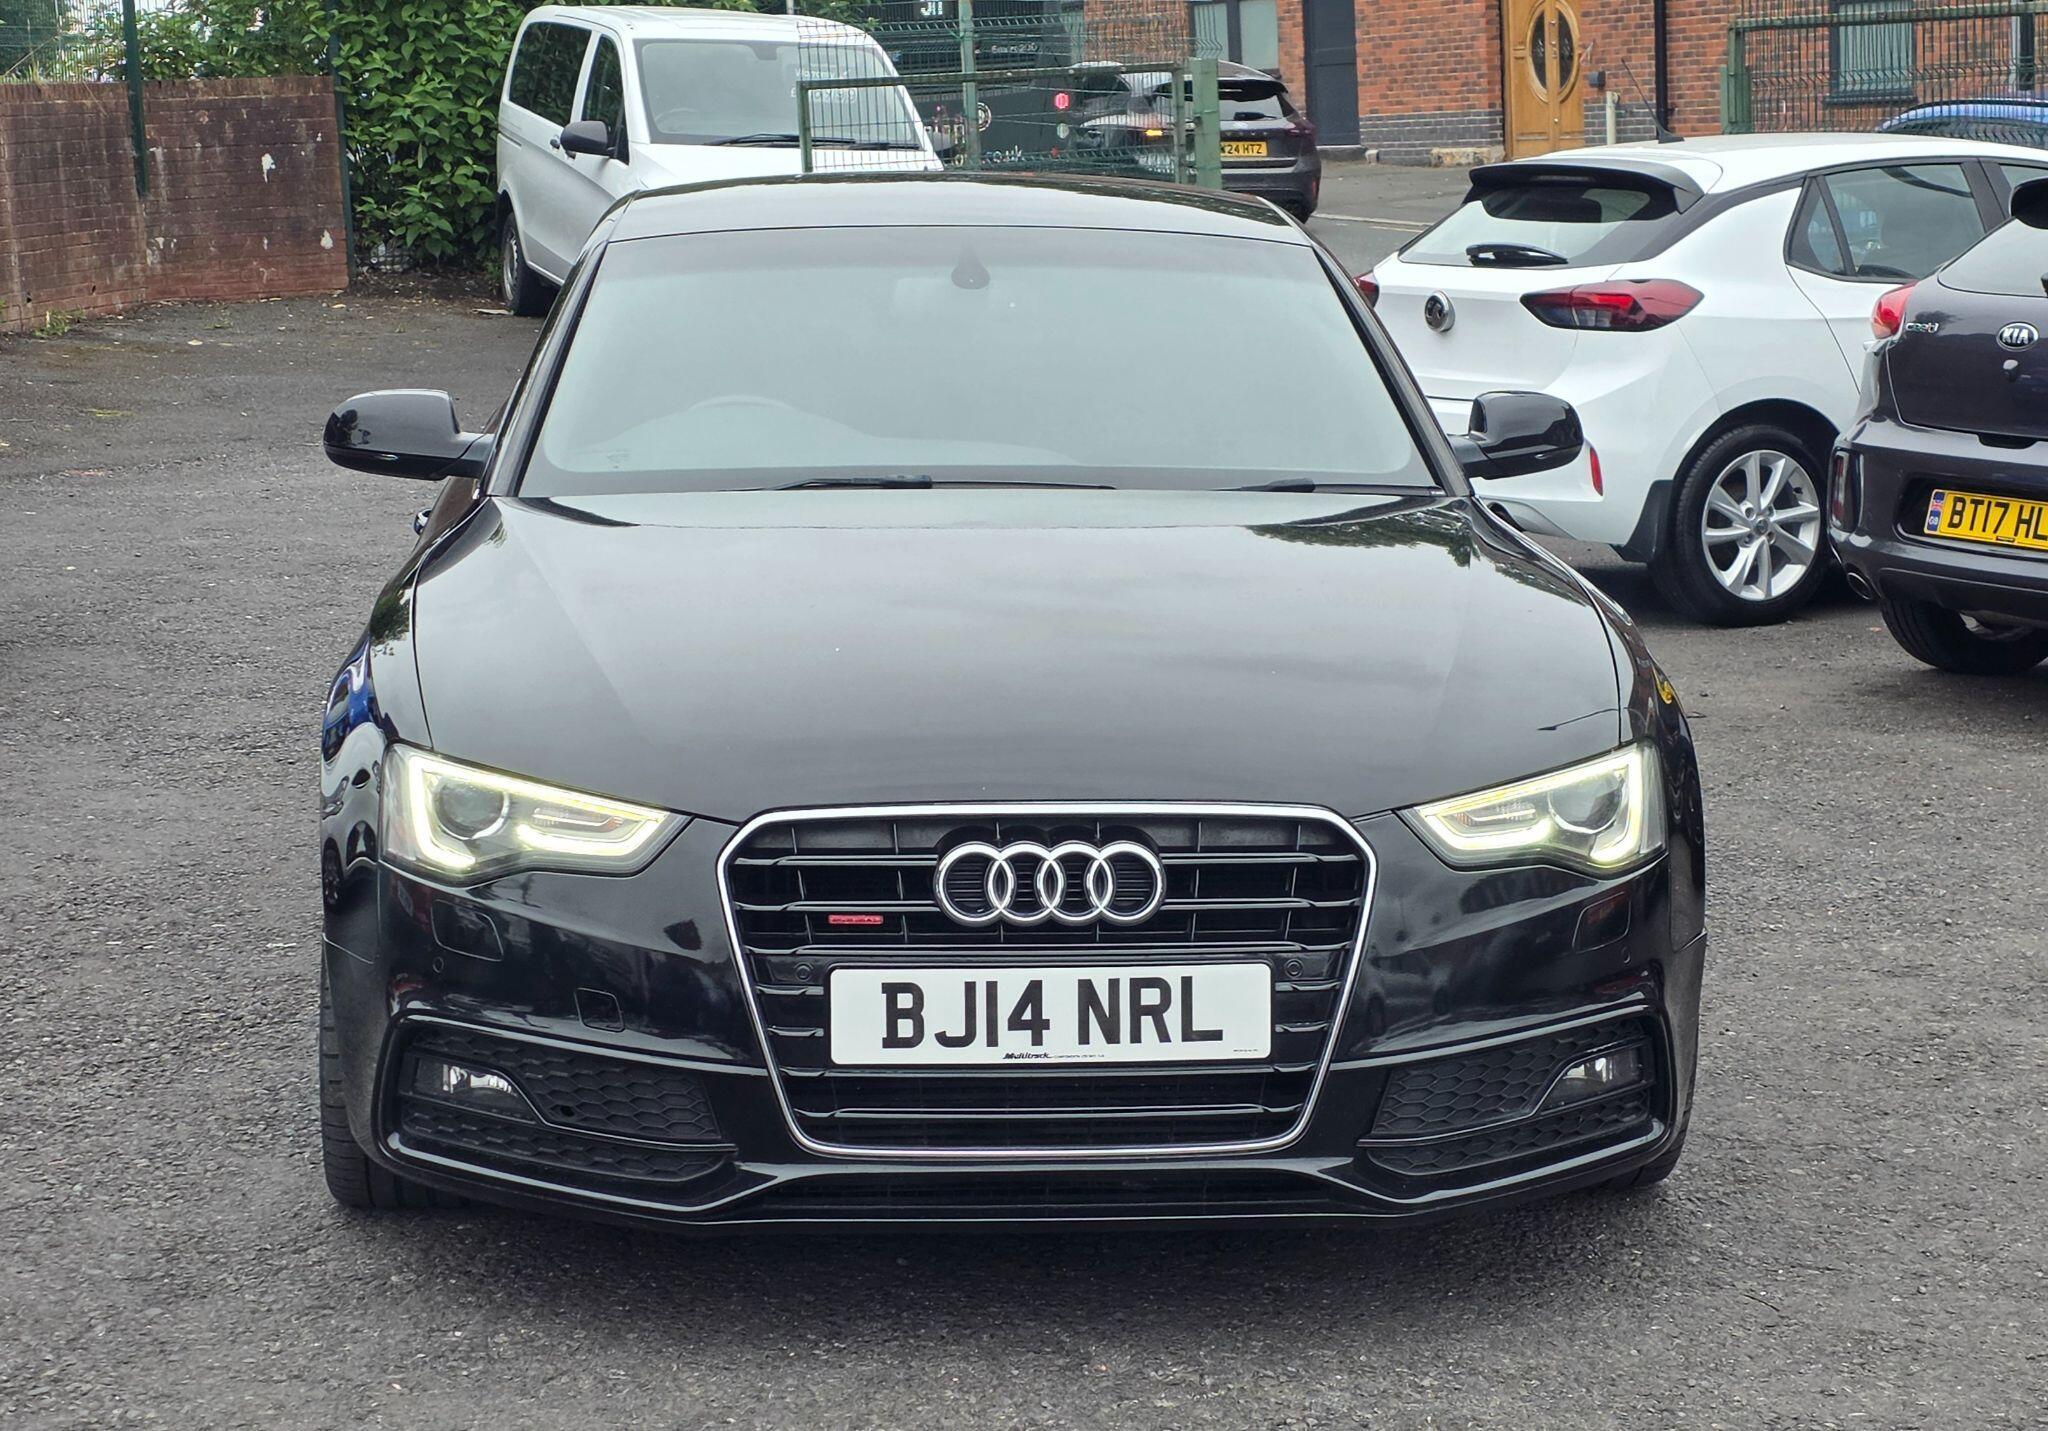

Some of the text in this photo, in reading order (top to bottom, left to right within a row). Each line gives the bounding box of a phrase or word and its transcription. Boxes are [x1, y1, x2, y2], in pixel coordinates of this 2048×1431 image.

[1243, 143, 1263, 154] HTZ
[2001, 327, 2030, 344] KIA
[1947, 496, 2048, 541] BT17 HL
[881, 976, 1224, 1049] BJ14 NRL
